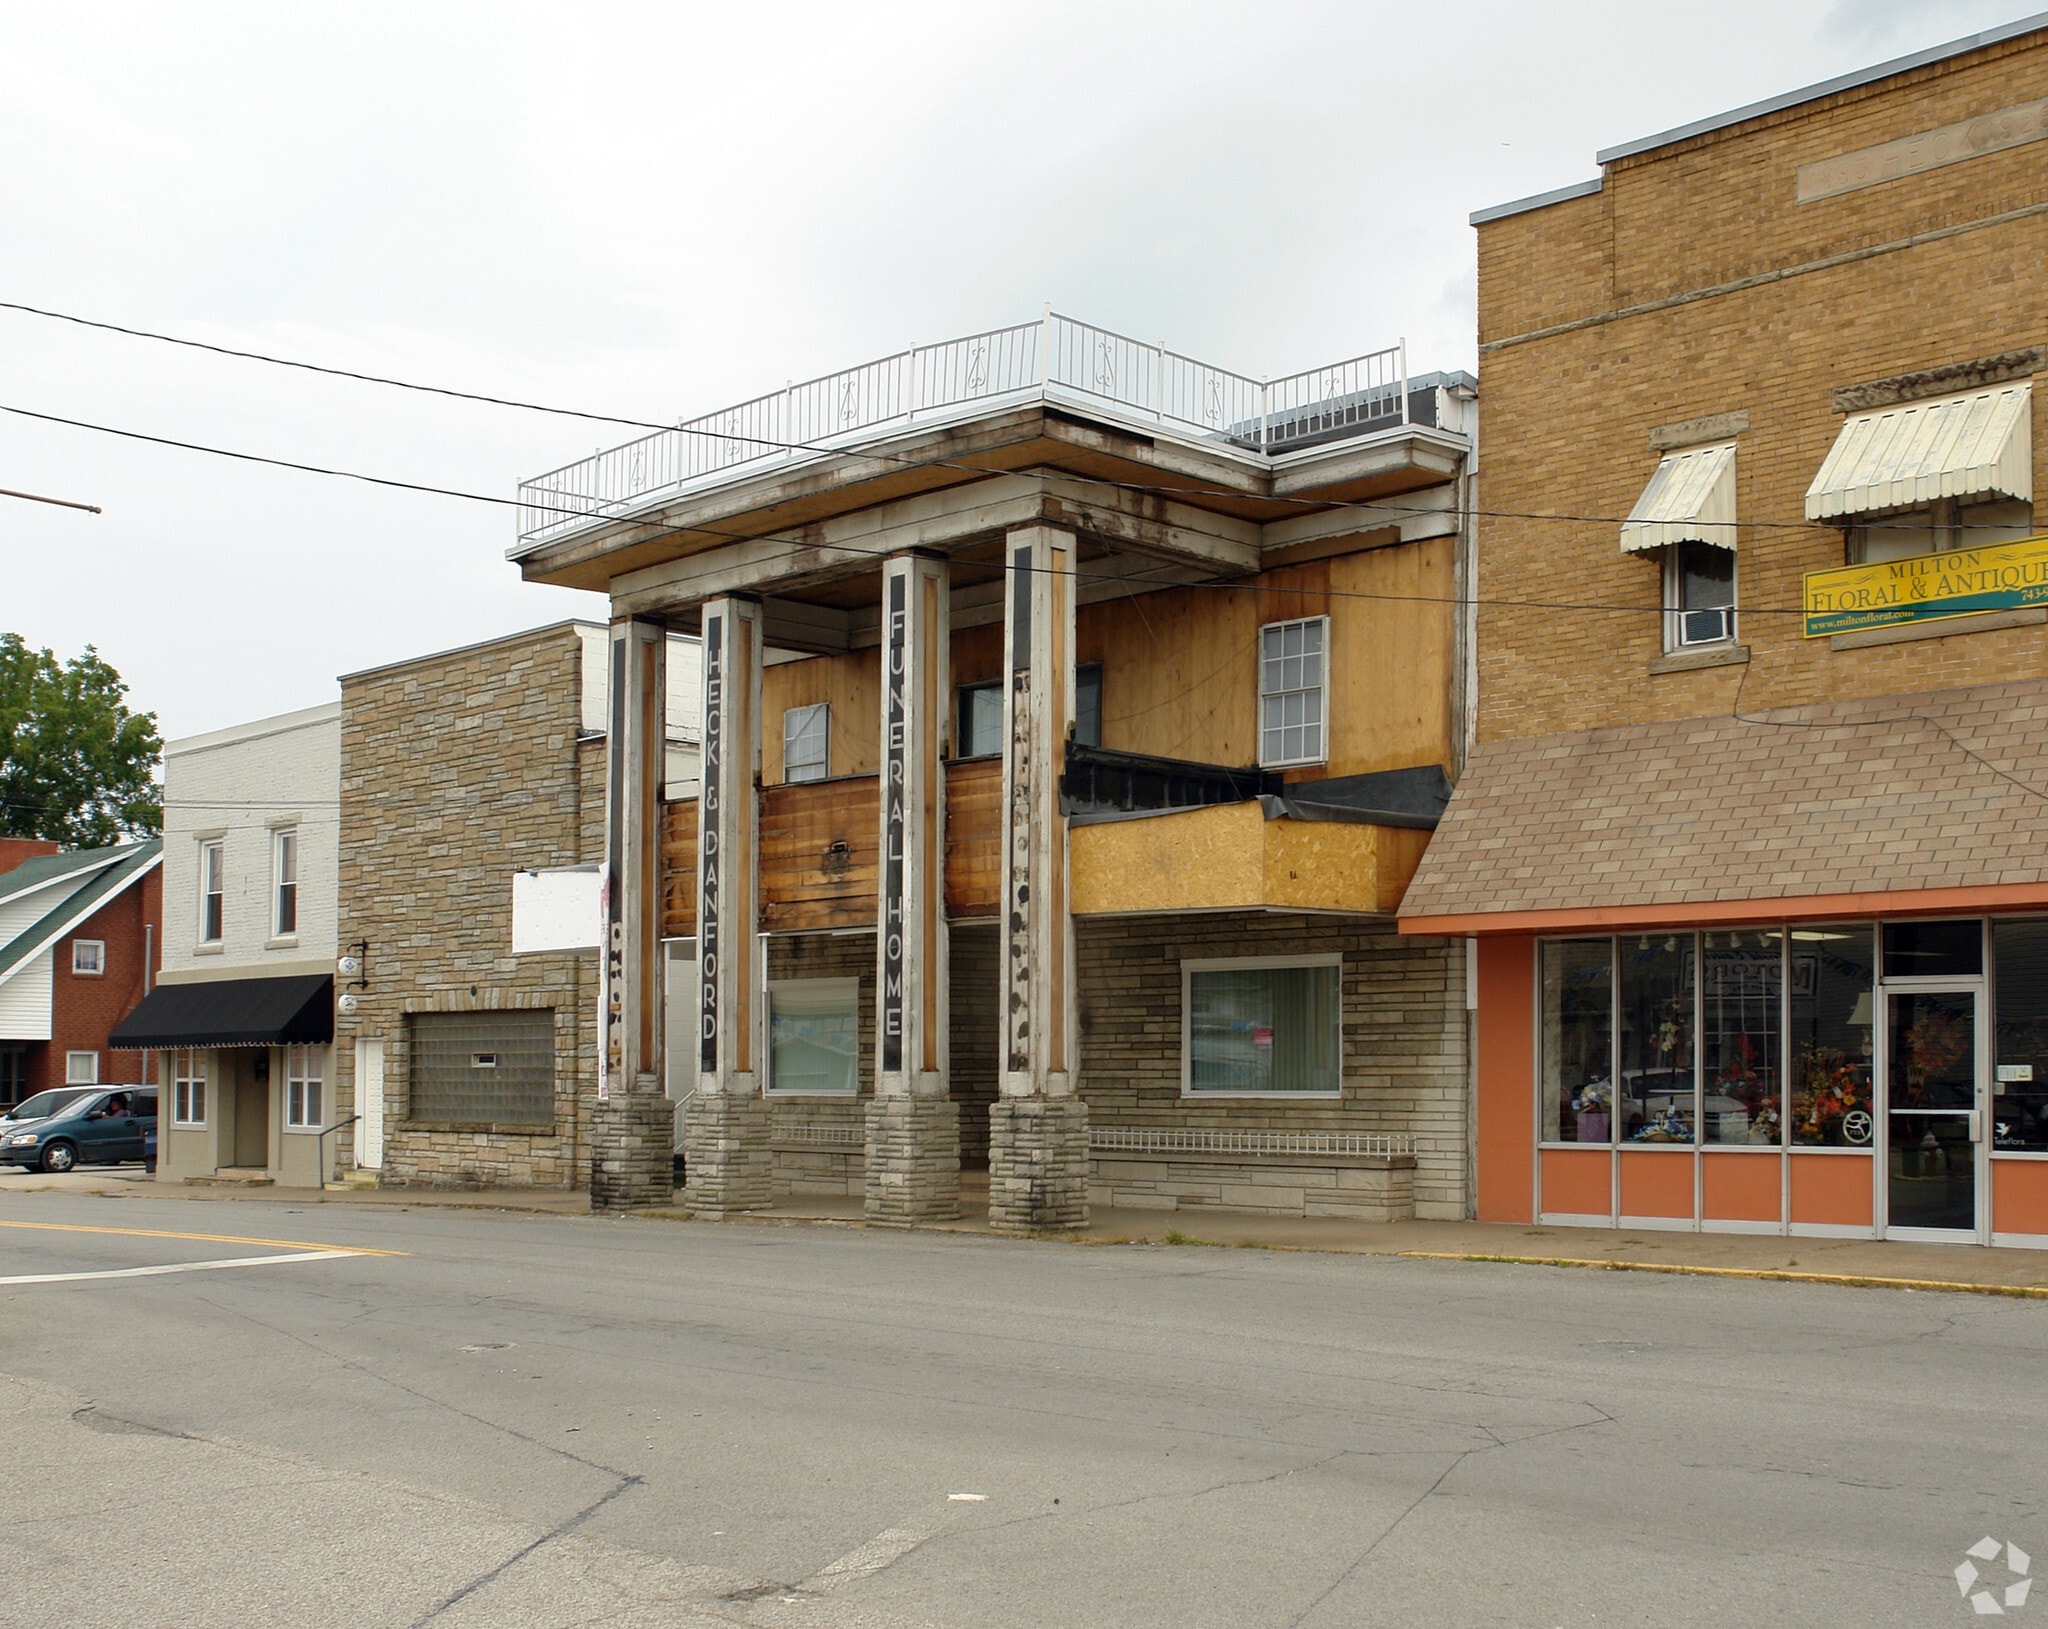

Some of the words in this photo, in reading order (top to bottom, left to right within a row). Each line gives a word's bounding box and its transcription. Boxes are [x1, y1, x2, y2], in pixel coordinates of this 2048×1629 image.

[1811, 583, 1903, 614] FLORAL
[1909, 577, 1927, 601] &
[1889, 552, 1981, 580] MILTON
[1810, 610, 1914, 631] www.miltonfloral.com
[705, 649, 722, 766] HECK
[888, 610, 905, 861] FUNERAL
[705, 785, 718, 810] &
[702, 830, 718, 1040] DANFORD
[886, 896, 902, 1036] HOME
